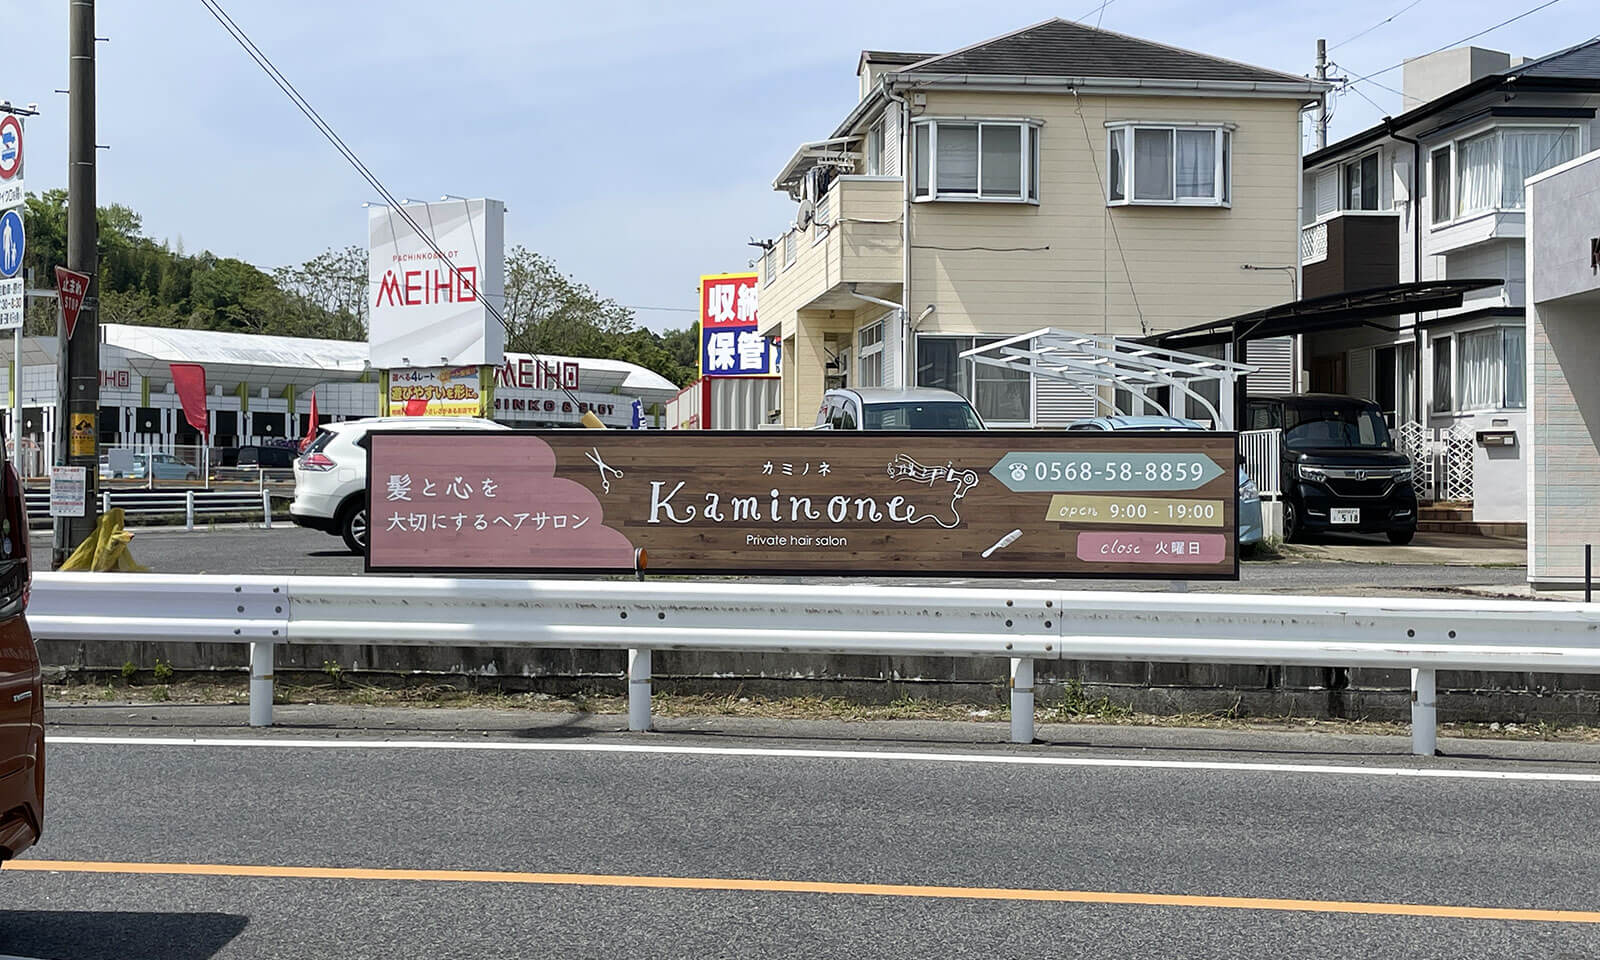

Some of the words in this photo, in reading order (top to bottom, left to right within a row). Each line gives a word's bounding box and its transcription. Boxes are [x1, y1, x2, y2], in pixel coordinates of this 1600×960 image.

[392, 250, 459, 262] PACHINKO&OT
[62, 277, 82, 296] 止まれ
[376, 266, 477, 307] MEIHO
[65, 296, 79, 310] STOP
[707, 331, 765, 371] 保管
[562, 401, 573, 412] &
[762, 461, 832, 476] カミノネ
[1035, 462, 1204, 481] 0568-58-8859
[386, 473, 499, 501] 髪と心を
[647, 481, 915, 524] Kaminone
[1059, 505, 1099, 517] open
[1110, 503, 1147, 518] 9:00
[1167, 503, 1215, 519] 19:00
[386, 511, 590, 532] 大切にするヘアサロン
[746, 534, 788, 546] Private
[790, 534, 813, 546] hair
[815, 535, 848, 546] salon
[1100, 539, 1142, 555] close
[1155, 541, 1201, 555] 火曜日
